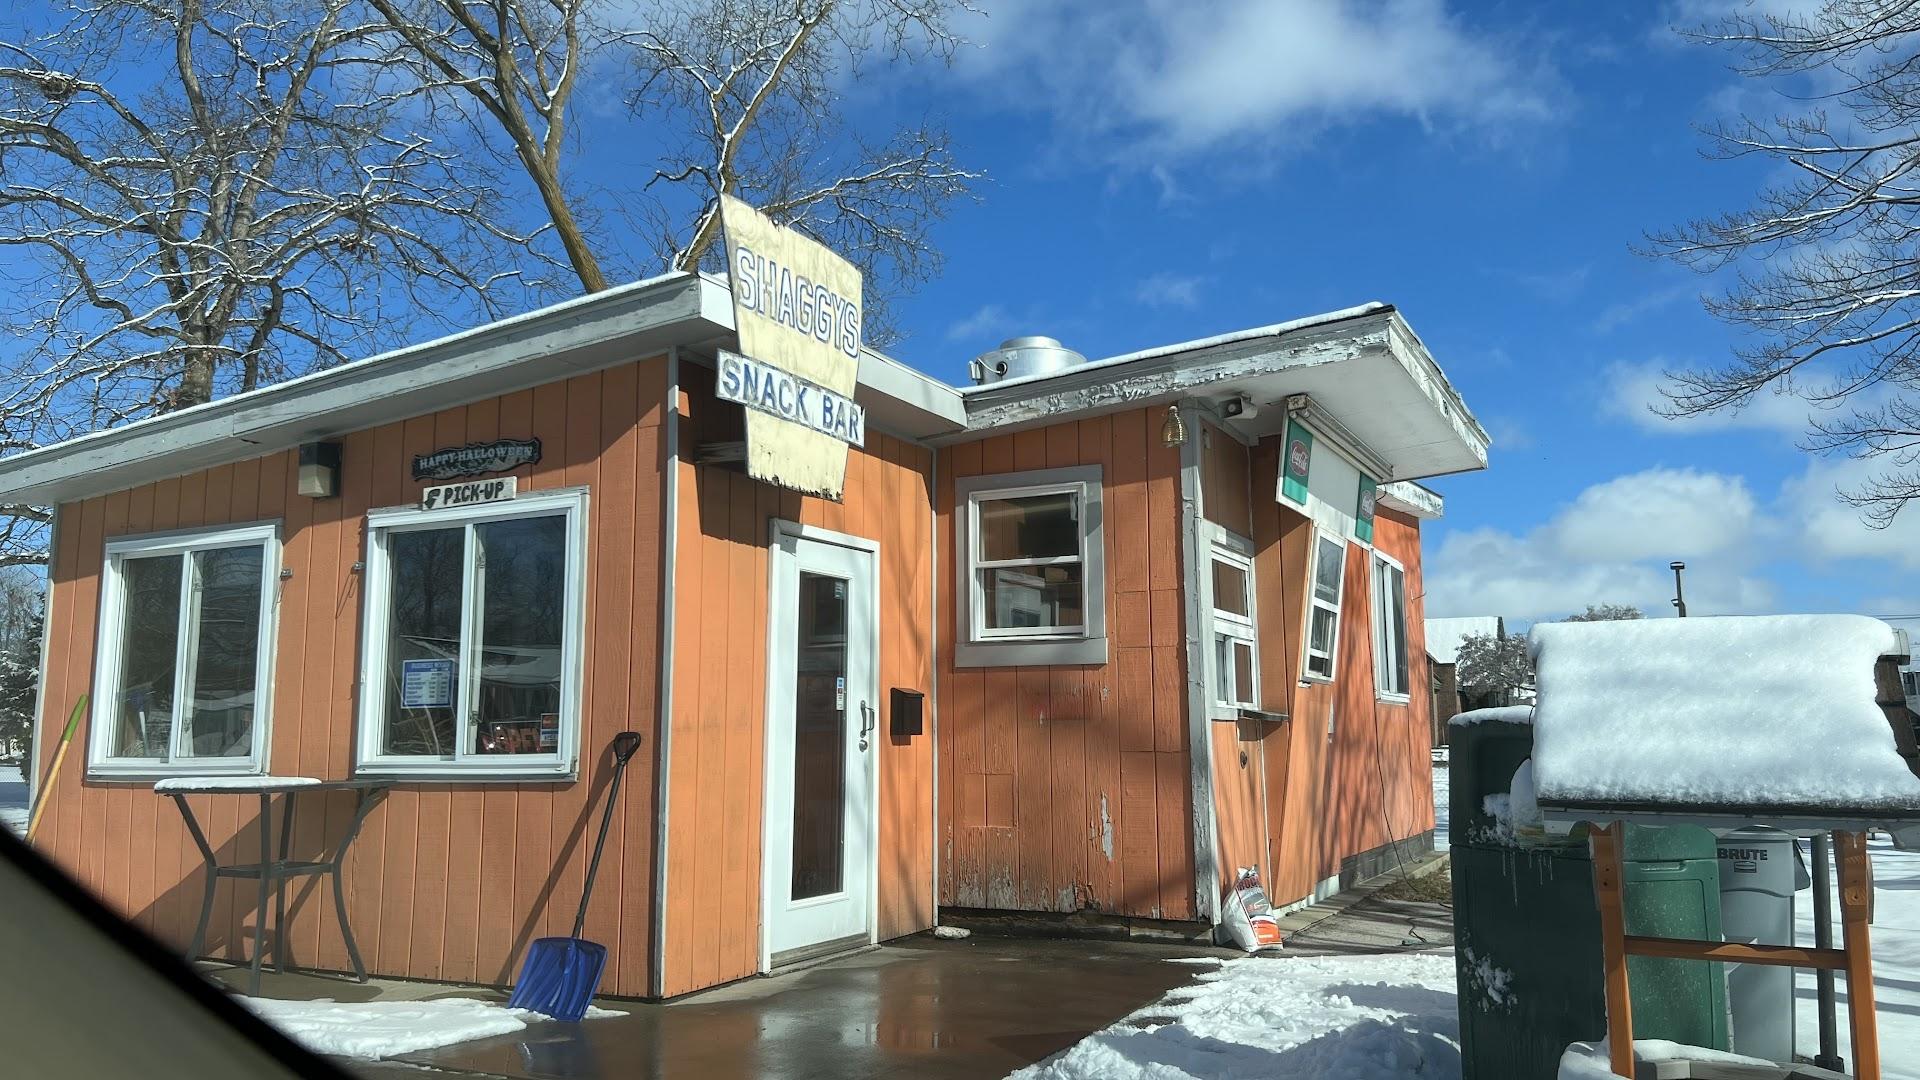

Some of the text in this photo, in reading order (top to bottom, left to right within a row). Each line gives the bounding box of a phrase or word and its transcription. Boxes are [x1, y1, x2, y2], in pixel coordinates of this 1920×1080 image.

[736, 247, 859, 359] SHAGGYS
[722, 358, 859, 441] SNACK BAR
[444, 481, 505, 505] PICK-UP
[1716, 847, 1768, 860] BRUTE
